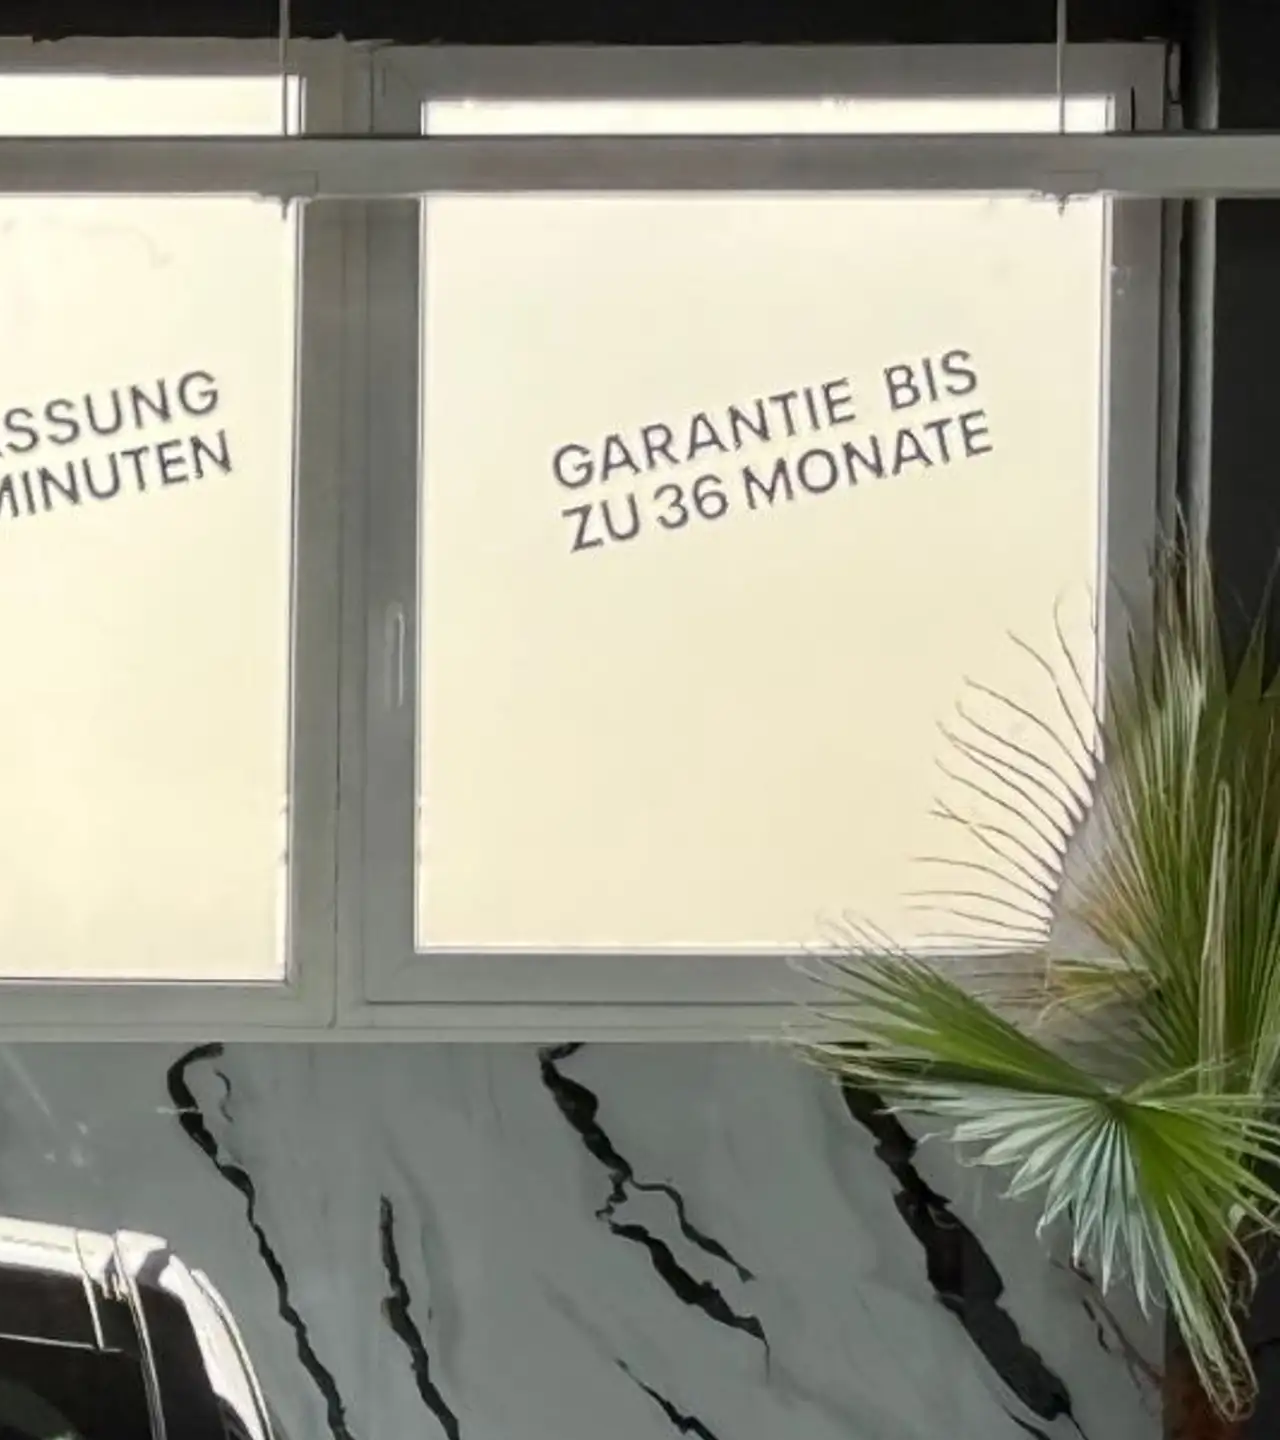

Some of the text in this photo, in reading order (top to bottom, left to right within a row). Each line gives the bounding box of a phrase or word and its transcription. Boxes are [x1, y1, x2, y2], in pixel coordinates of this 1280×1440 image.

[553, 350, 977, 489] GARANTIE BIS
[563, 410, 992, 552] ZU 36 MONATE
